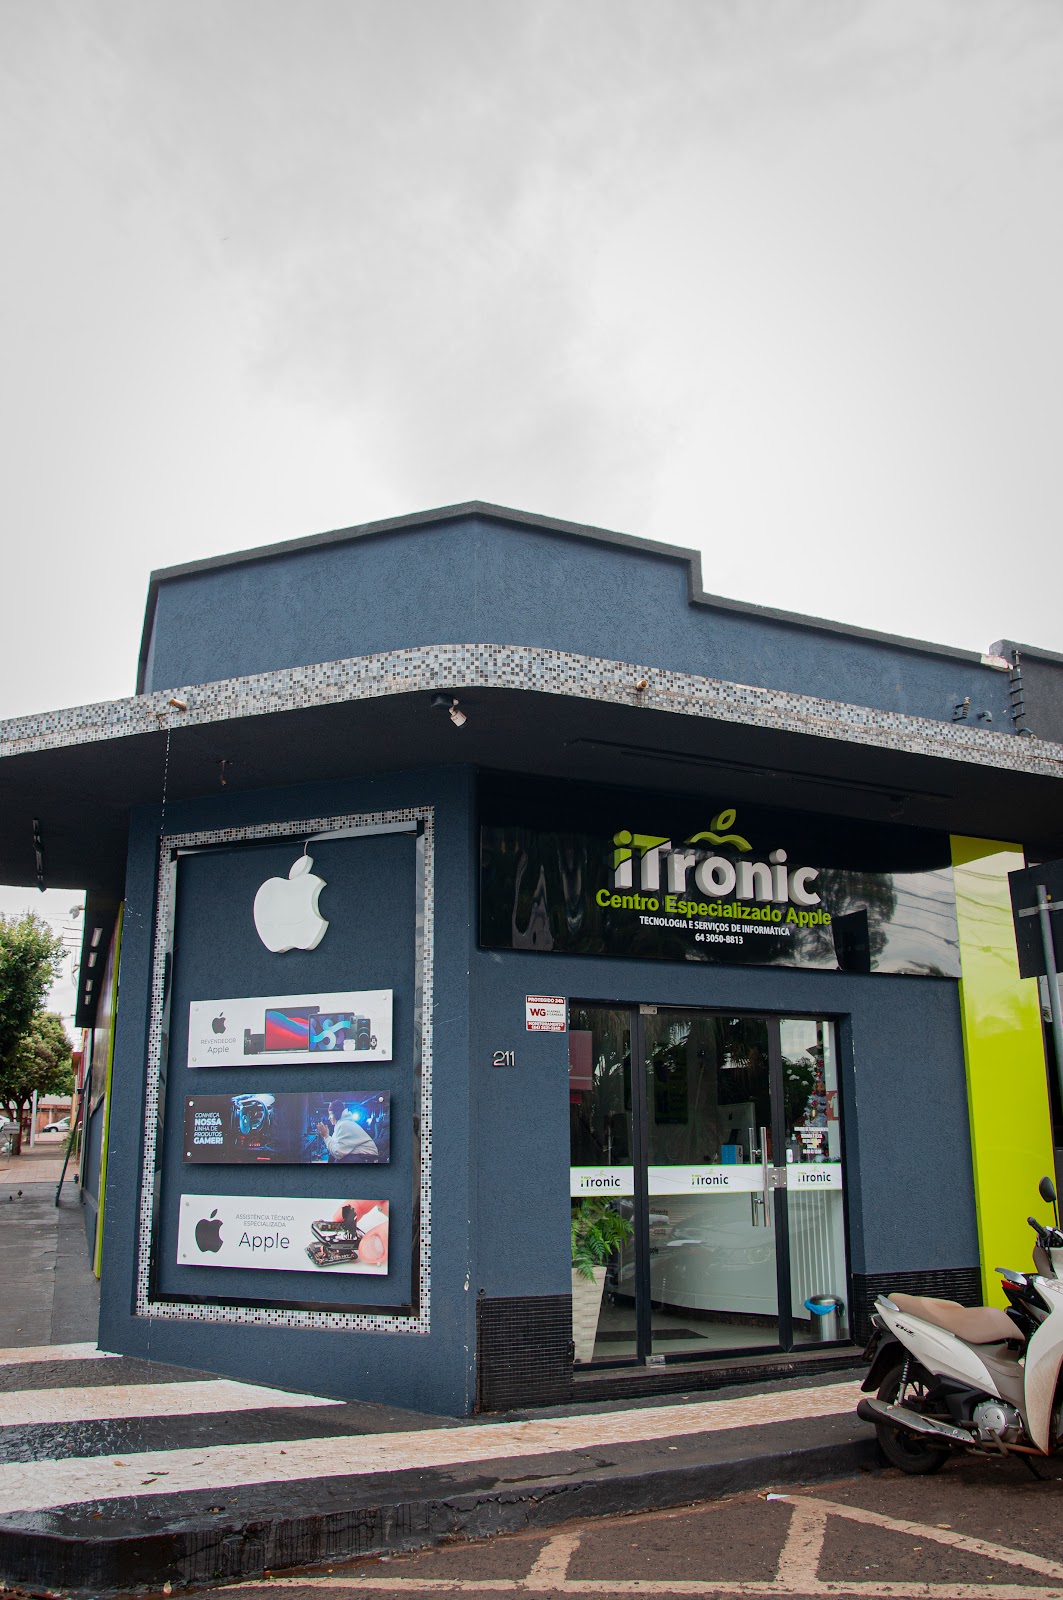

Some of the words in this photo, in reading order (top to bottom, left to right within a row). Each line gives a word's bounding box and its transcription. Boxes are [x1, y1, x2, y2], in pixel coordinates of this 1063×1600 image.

[613, 830, 822, 906] iTronic
[595, 888, 660, 912] Centro
[665, 895, 782, 923] Especializado
[785, 906, 832, 928] Apple
[639, 915, 688, 929] TECNOLOGIA
[688, 920, 694, 930] E
[694, 920, 730, 933] SERVIÇOS
[731, 923, 742, 933] DE
[742, 923, 791, 936] INFORMÁTICA
[695, 932, 705, 942] 64
[705, 934, 744, 945] 3050-8813
[529, 1008, 546, 1016] WG
[207, 1046, 230, 1055] Apple
[493, 1050, 515, 1066] 211
[194, 1118, 222, 1126] NOSSA
[193, 1136, 223, 1145] GAMER!
[580, 1175, 621, 1188] iTronic
[691, 1173, 729, 1185] iTronic
[797, 1171, 832, 1182] iTronic
[243, 1220, 287, 1228] ESPECIALIZADA
[270, 1214, 295, 1222] TÉCNICA
[238, 1231, 290, 1252] Apple
